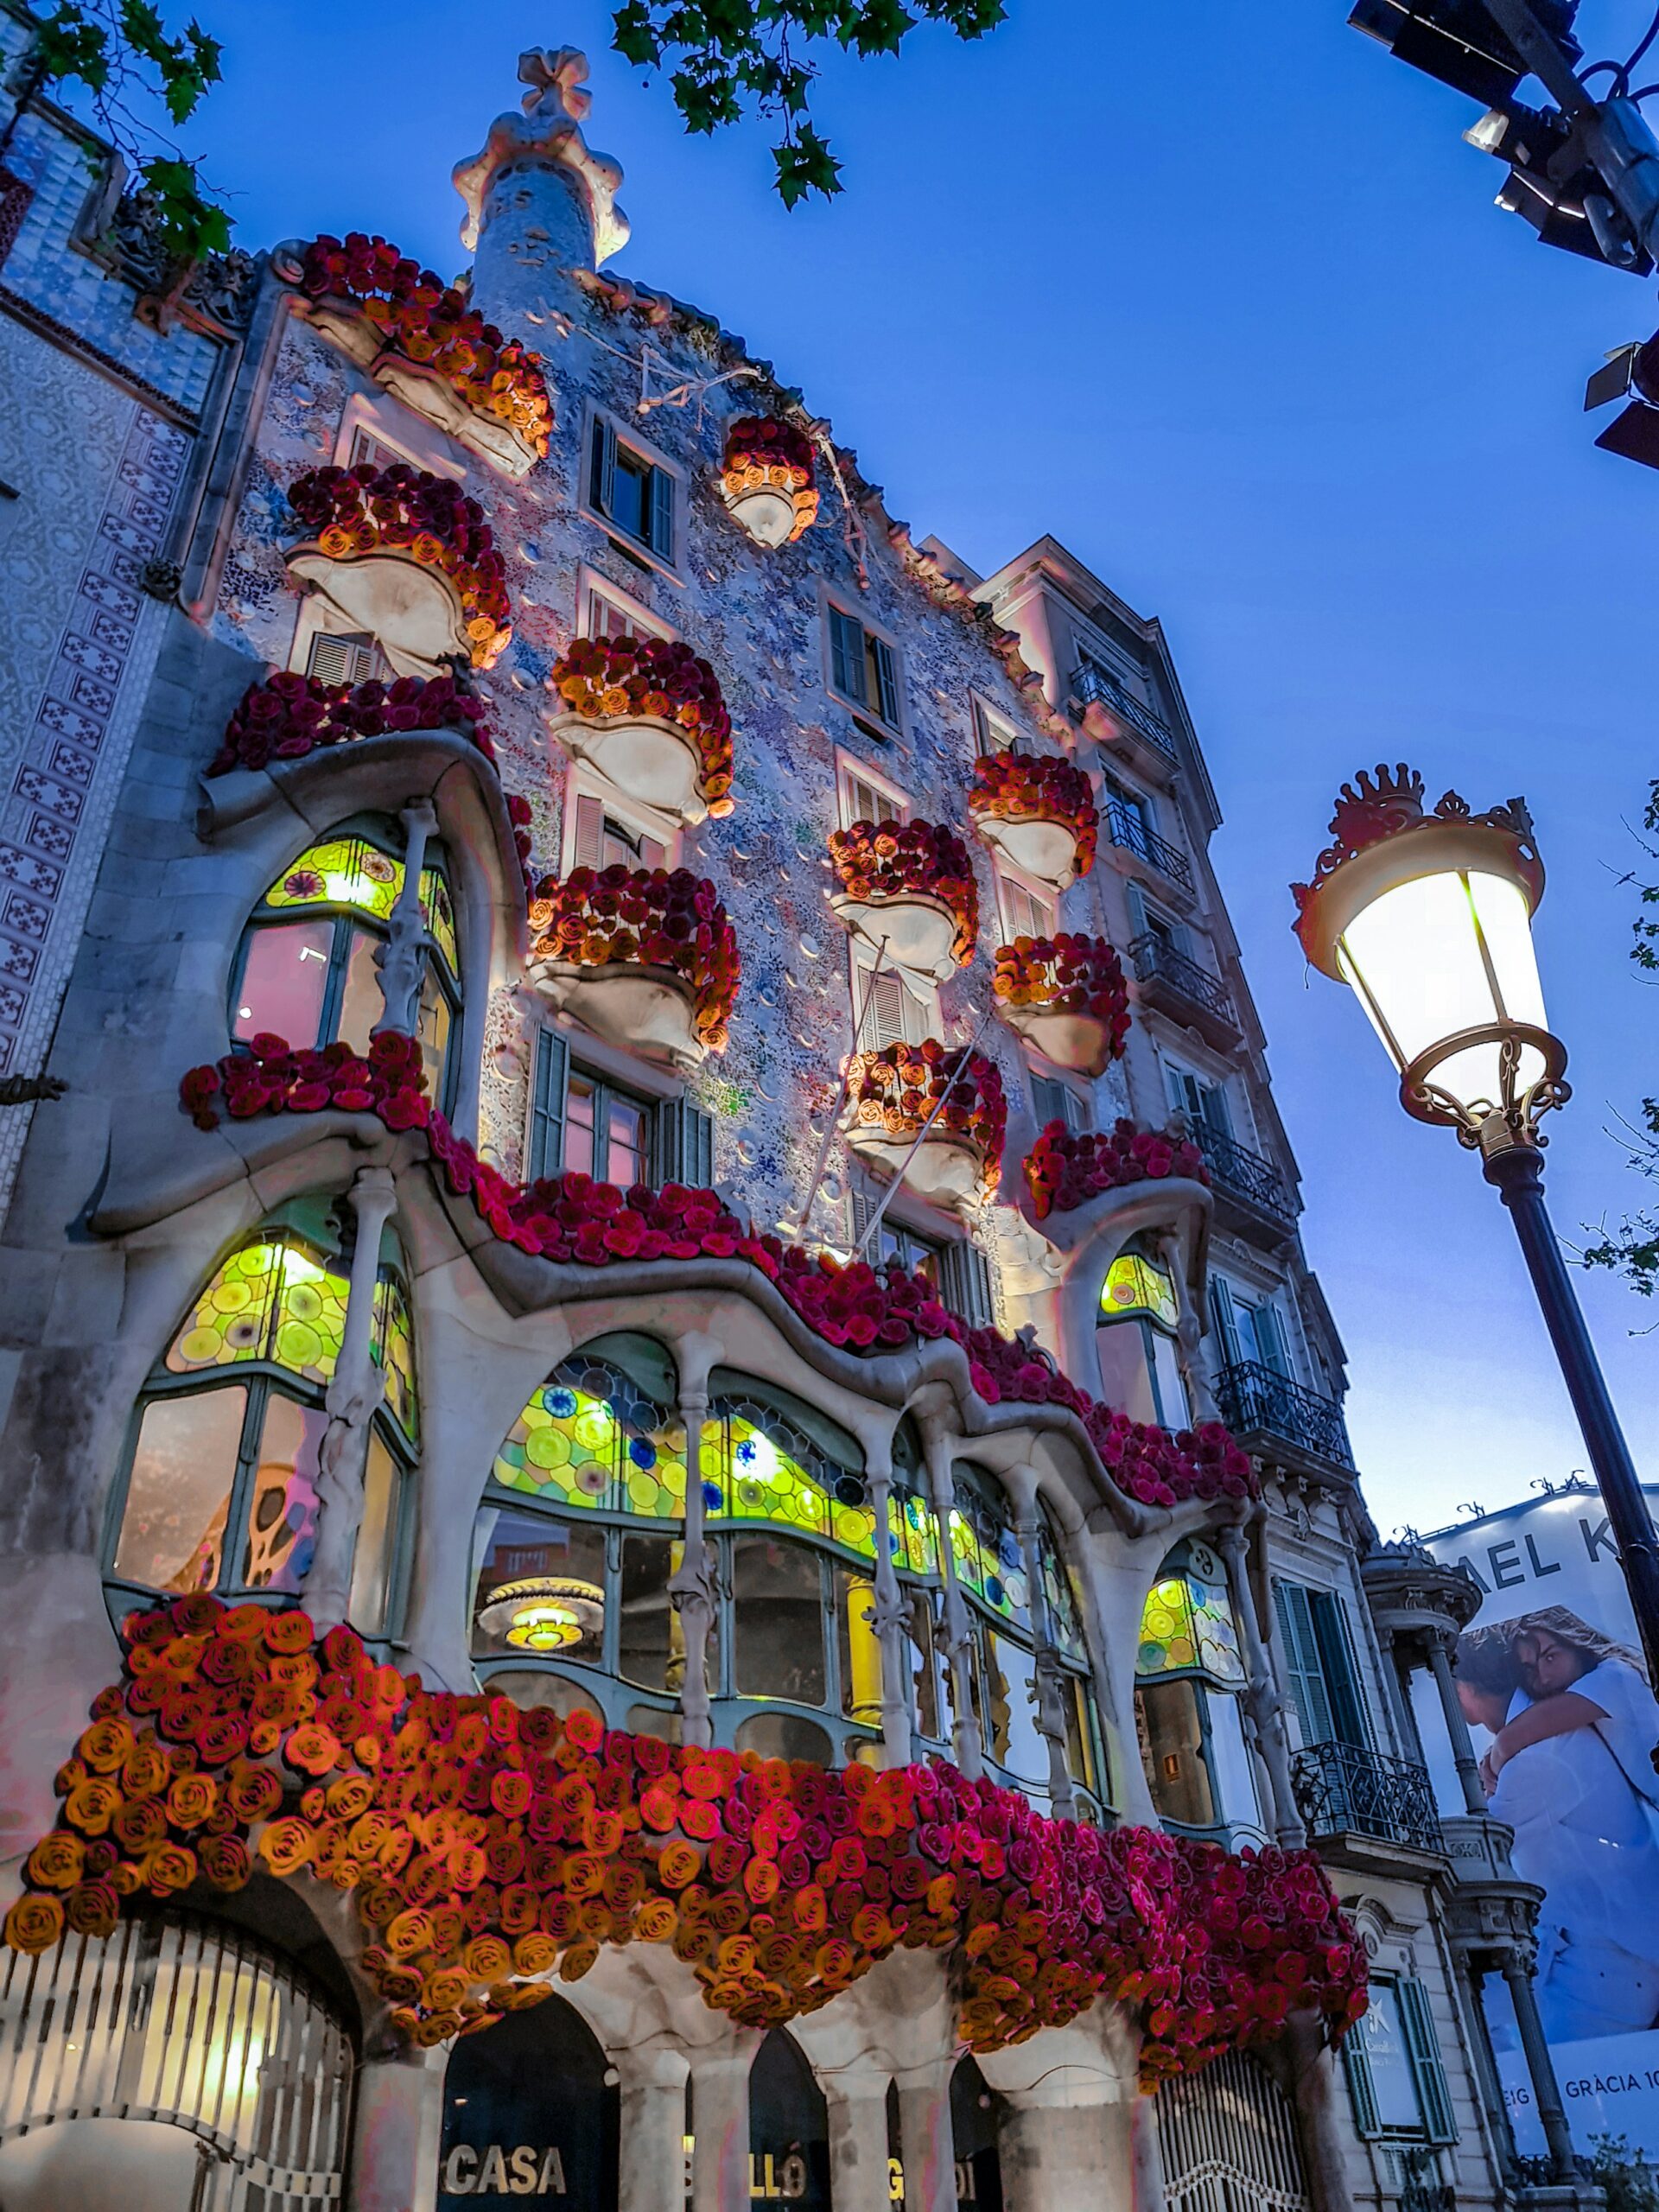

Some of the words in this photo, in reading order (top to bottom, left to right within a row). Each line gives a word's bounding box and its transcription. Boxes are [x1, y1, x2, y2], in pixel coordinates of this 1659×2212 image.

[1459, 1535, 1560, 1593] AEL
[1580, 1518, 1618, 1562] K
[1503, 2088, 1529, 2107] EIG
[1566, 2074, 1642, 2098] GRÀCIA
[445, 2144, 567, 2195] CASA
[748, 2139, 806, 2197] LLÓ
